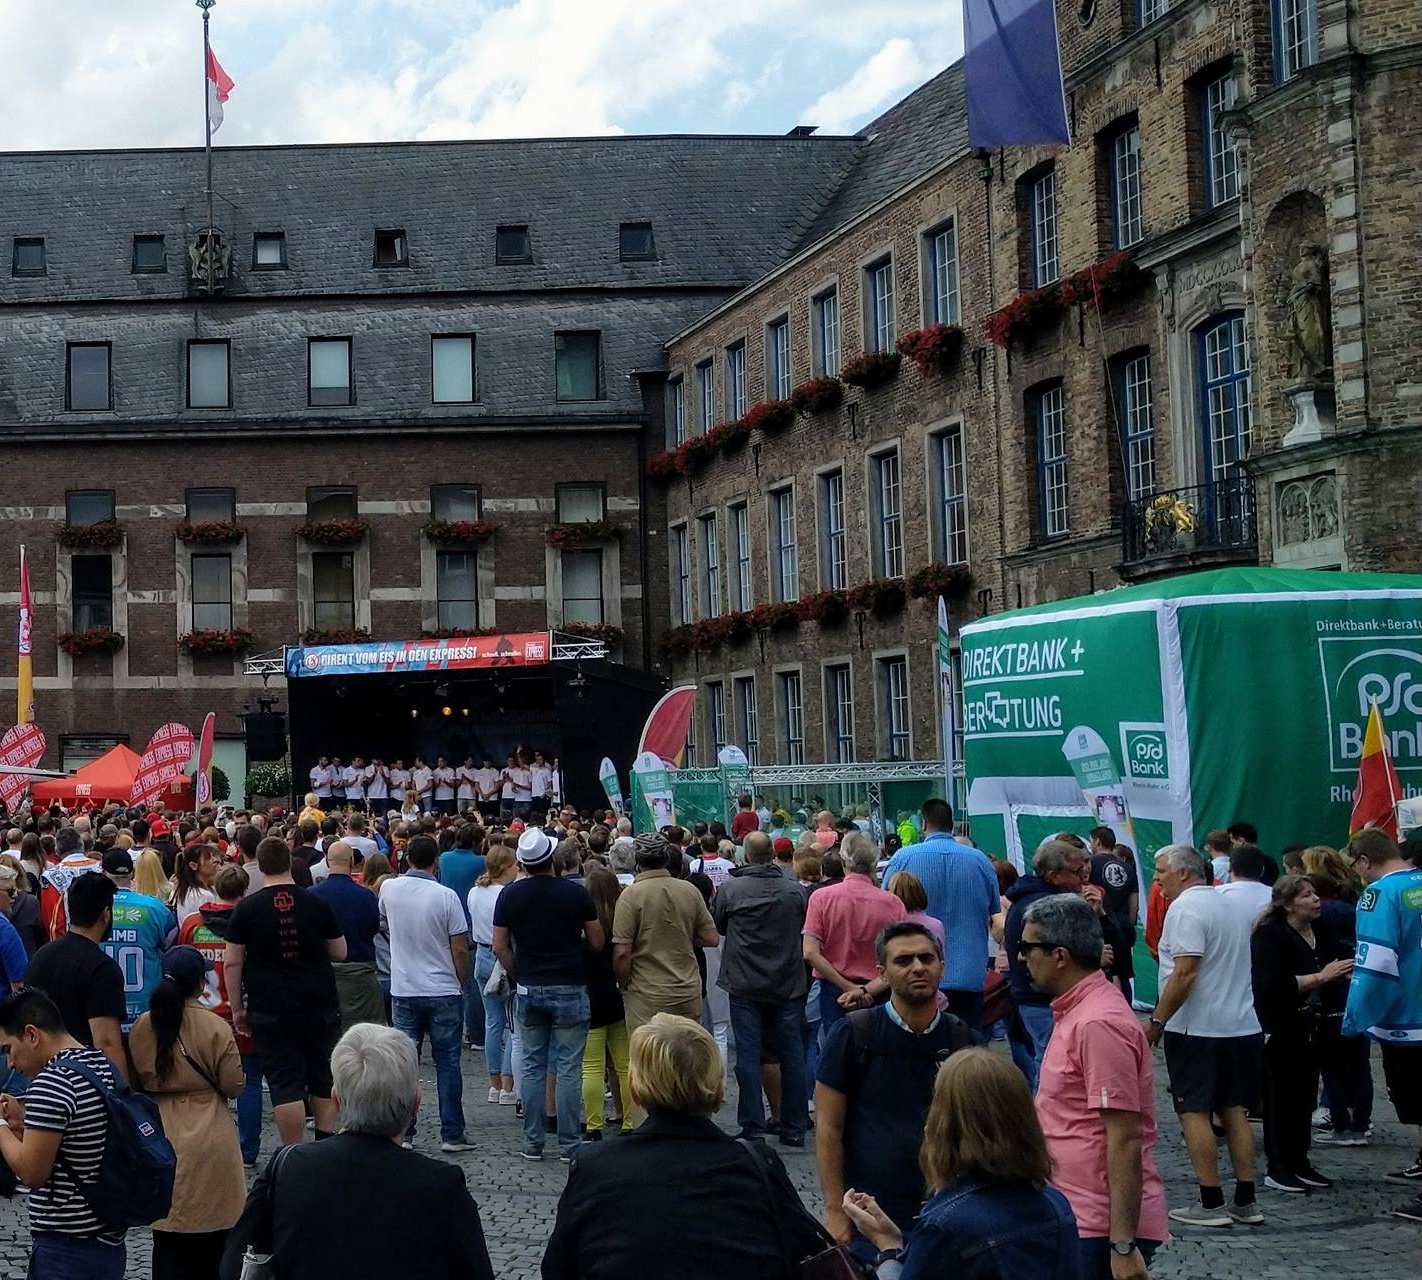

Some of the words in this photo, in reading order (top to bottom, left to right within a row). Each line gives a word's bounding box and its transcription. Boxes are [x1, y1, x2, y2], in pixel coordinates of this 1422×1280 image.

[321, 653, 355, 666] DIREKT
[355, 652, 378, 665] VOM
[379, 651, 394, 663] EIS
[396, 650, 407, 662] IN
[409, 648, 428, 661] DEN
[429, 646, 477, 660] EXPRESS!
[963, 637, 1068, 680] DIREKTBANK
[1131, 760, 1166, 776] Bank
